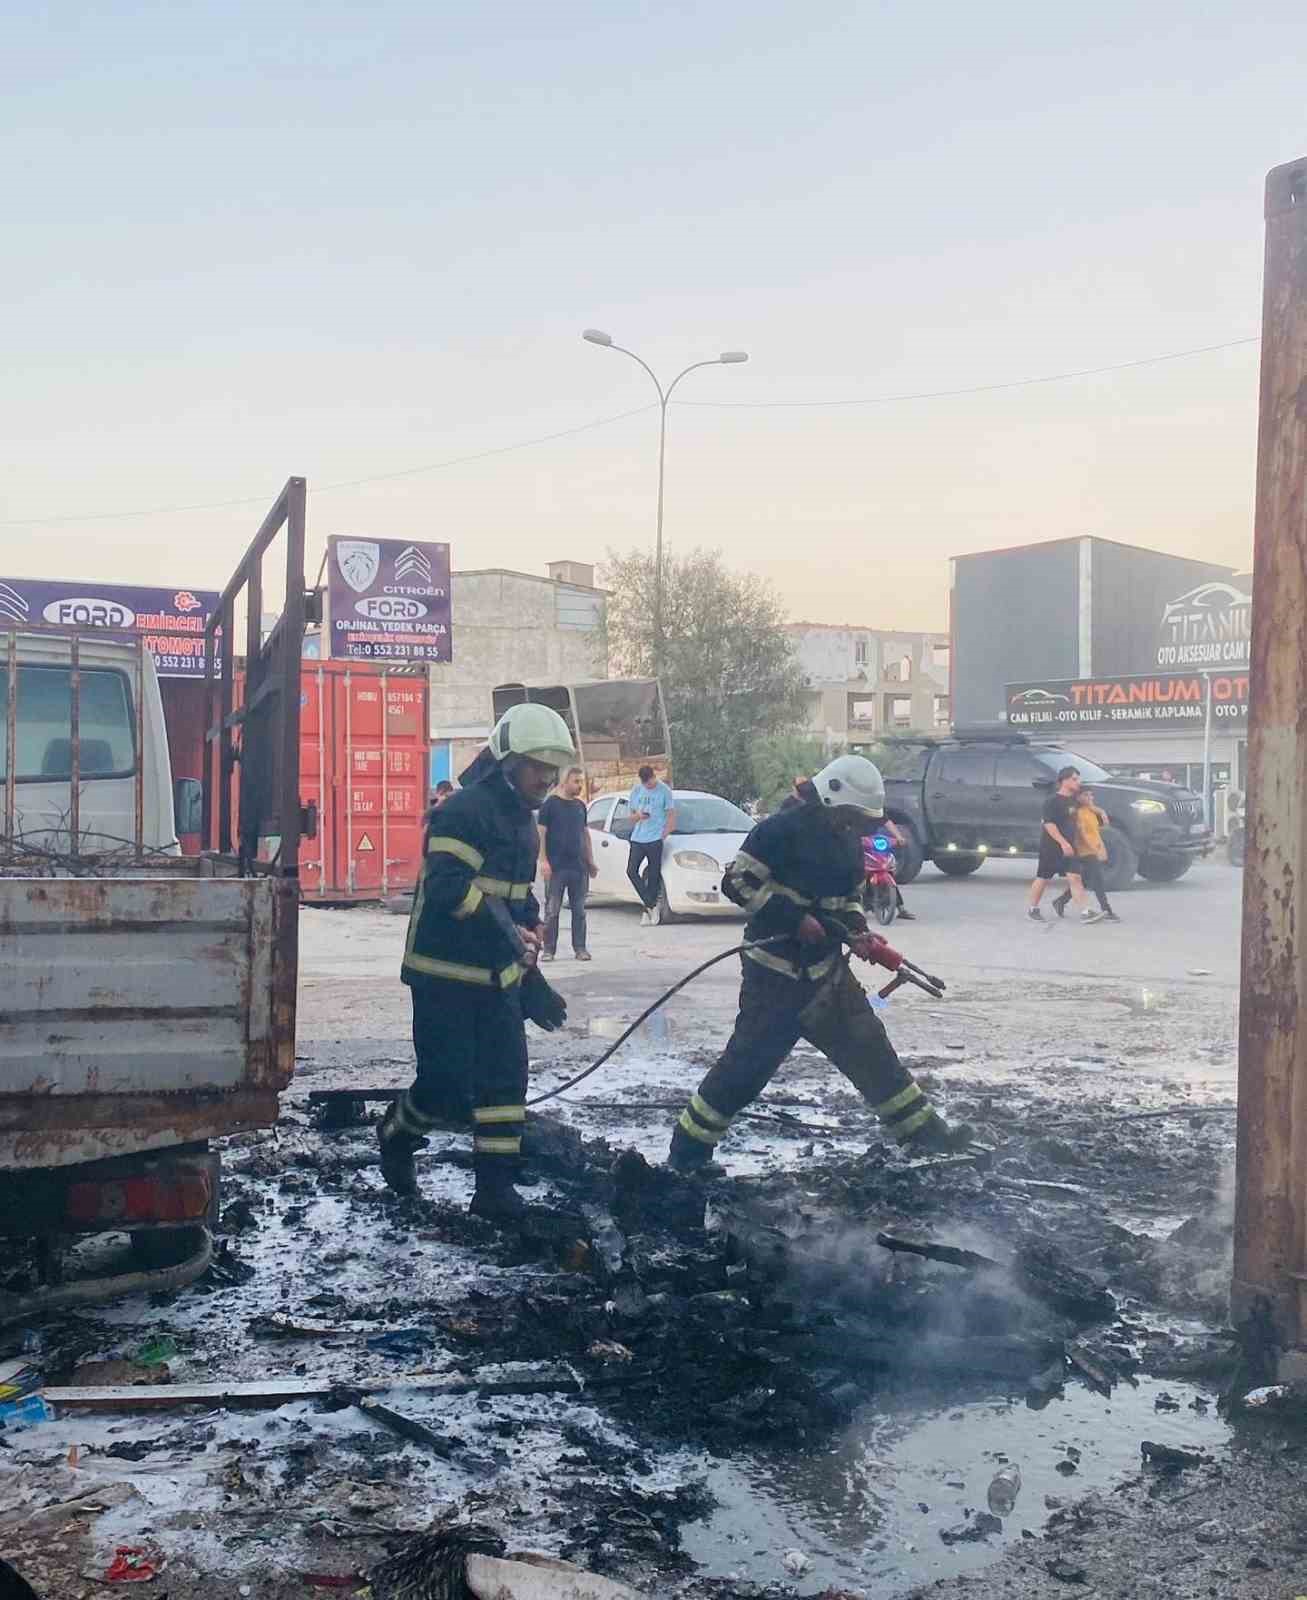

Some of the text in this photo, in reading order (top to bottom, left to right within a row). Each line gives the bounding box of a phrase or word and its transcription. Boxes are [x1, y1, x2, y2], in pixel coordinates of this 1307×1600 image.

[59, 604, 125, 627] FORD
[367, 600, 419, 618] FORD
[380, 622, 414, 633] YEDEK
[415, 623, 447, 634] PARÇA
[1168, 608, 1251, 642] TITANIU
[373, 645, 392, 655] 552
[394, 646, 411, 656] 231
[413, 646, 425, 656] 88
[427, 647, 439, 657] 55
[1158, 647, 1176, 665] OTO
[1177, 643, 1222, 664] AKSESUAR
[1223, 641, 1245, 660] CAM
[163, 656, 178, 668] 552
[180, 657, 195, 669] 231
[1071, 677, 1249, 705] TITANIUM OT
[1010, 711, 1029, 724] CAM
[1111, 707, 1152, 720] SERAMİK
[1154, 705, 1202, 719] KAPLAMA
[1215, 704, 1238, 717] OTO
